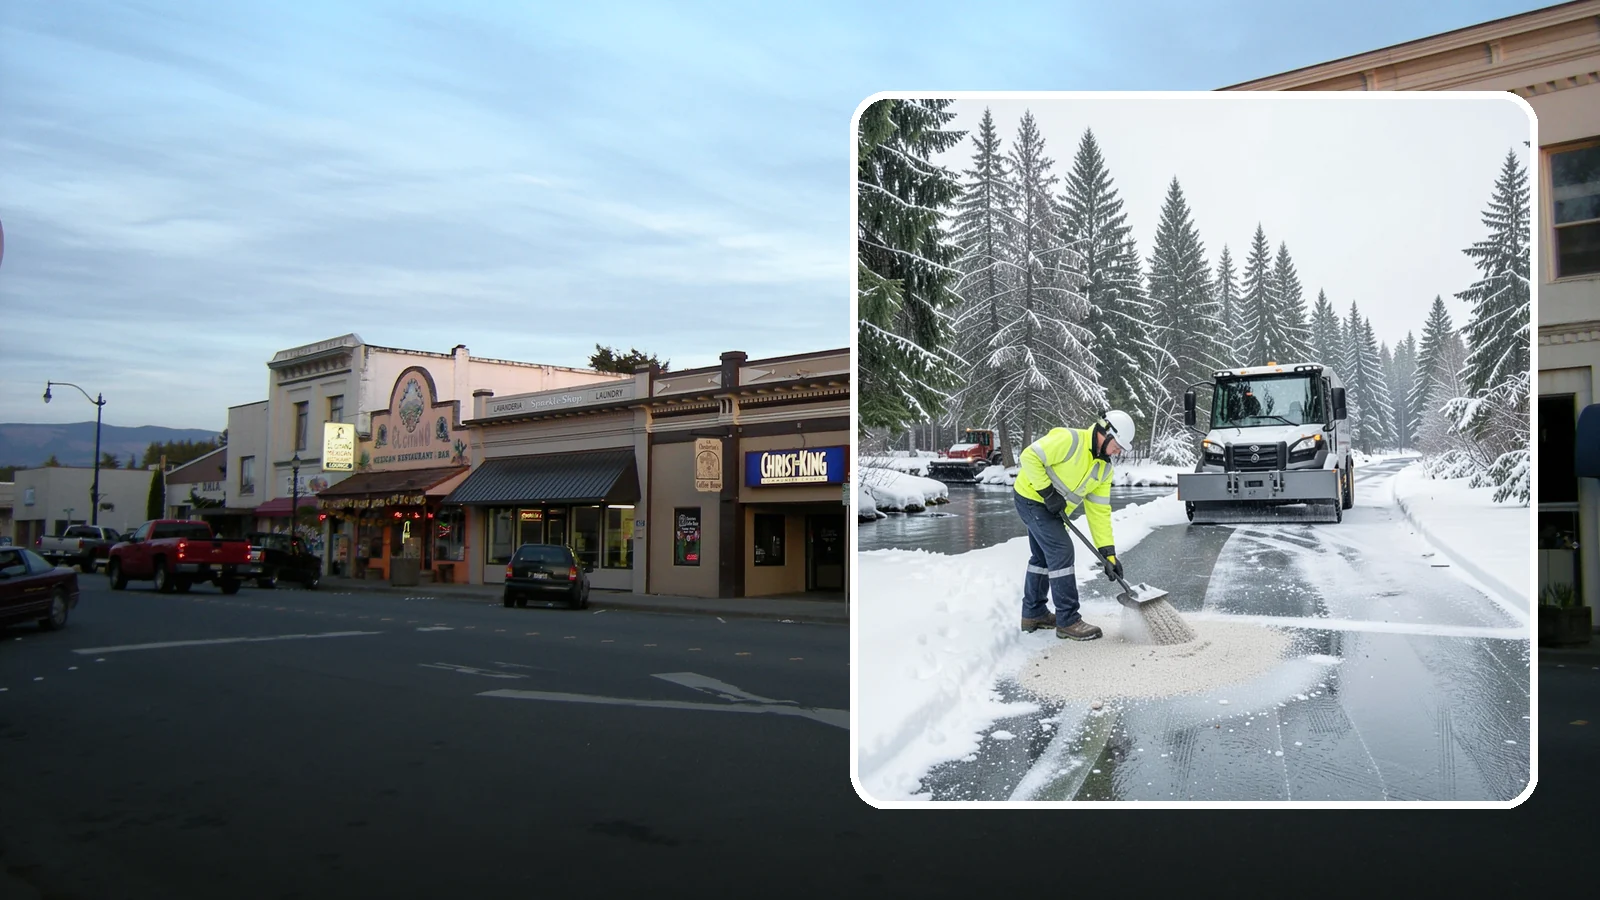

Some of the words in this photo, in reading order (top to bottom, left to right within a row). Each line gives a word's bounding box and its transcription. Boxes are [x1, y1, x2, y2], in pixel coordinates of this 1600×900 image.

[595, 389, 623, 400] LAUNDRY
[493, 401, 522, 413] LAVANDERIA
[530, 397, 561, 409] Sparkle
[562, 394, 582, 406] Shop
[373, 455, 396, 464] MEXICAN
[397, 451, 433, 462] RESTAURANT
[438, 450, 450, 459] BAR
[760, 452, 798, 478] CHRIST
[798, 450, 828, 477] KING
[697, 480, 709, 489] Coffee
[709, 480, 721, 489] House
